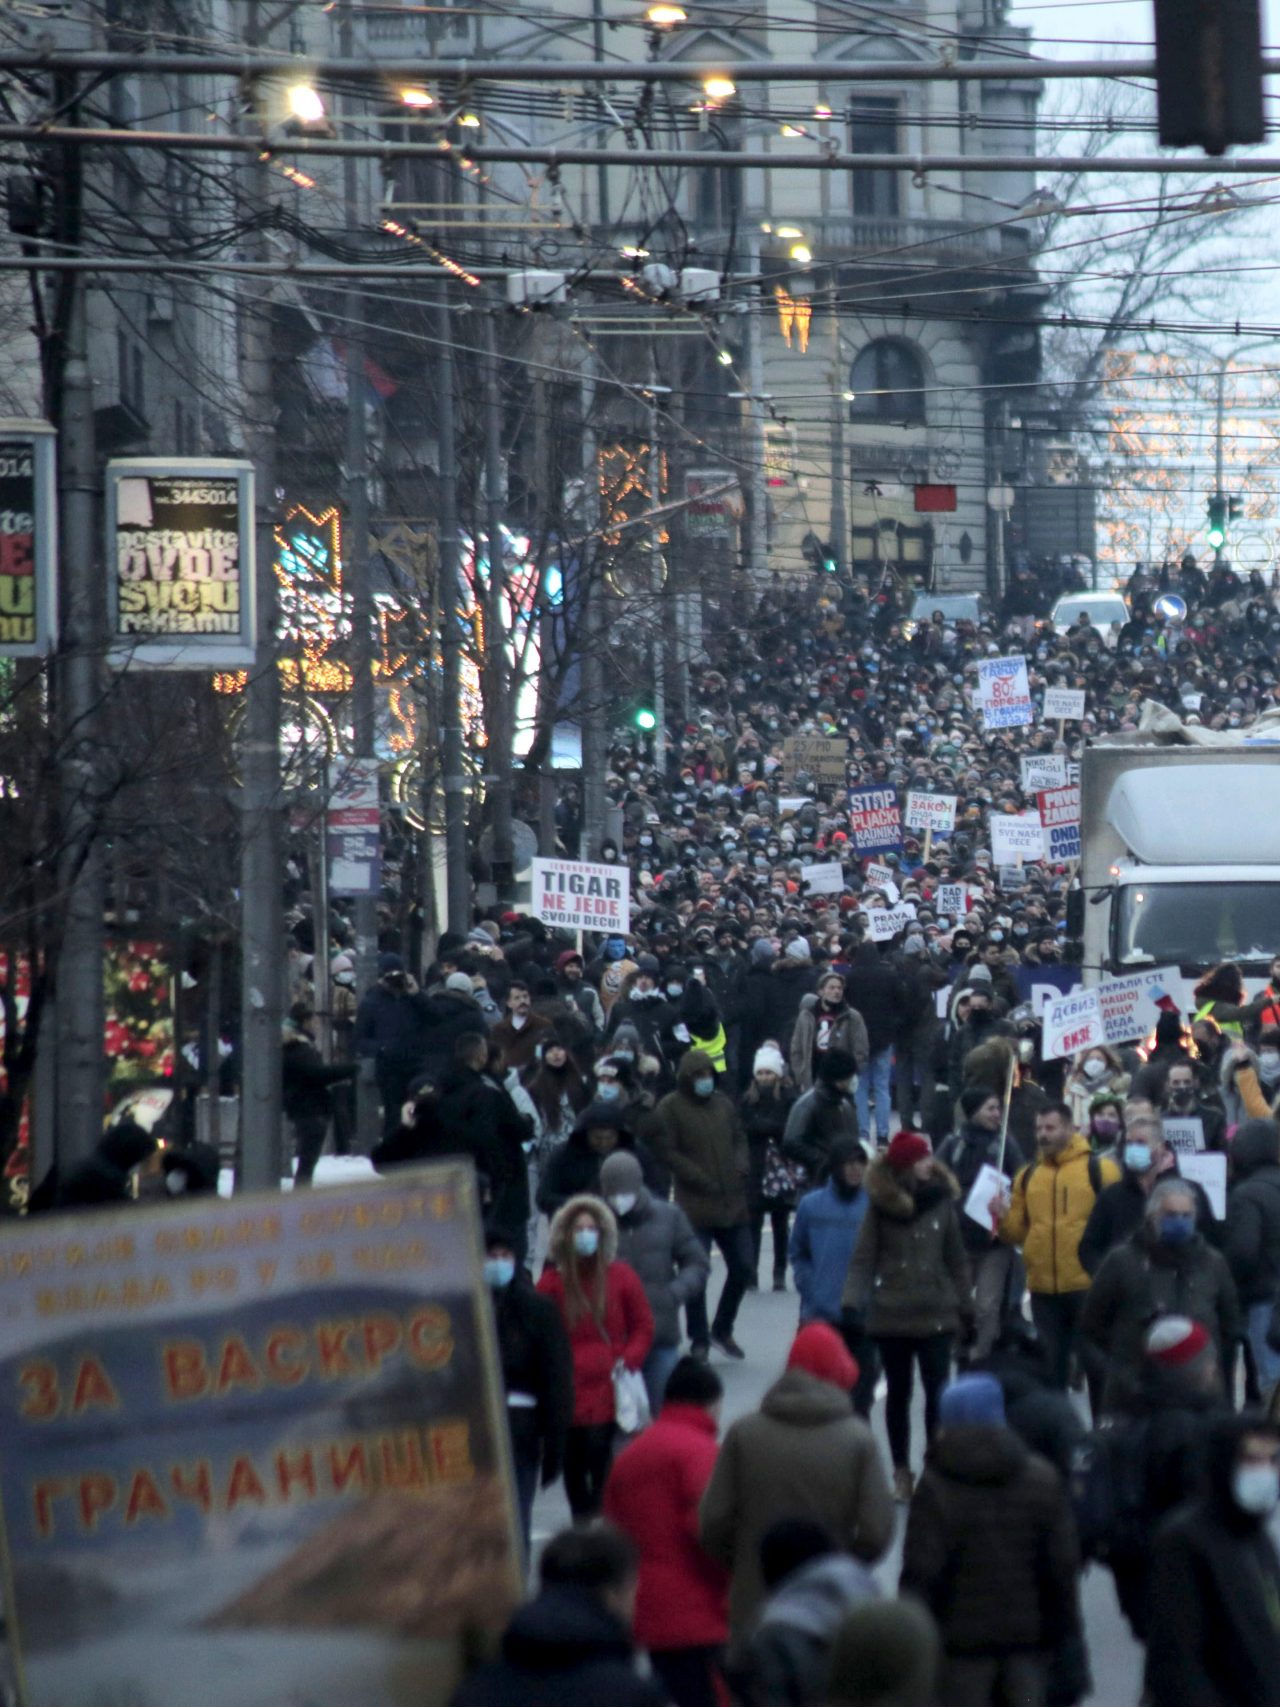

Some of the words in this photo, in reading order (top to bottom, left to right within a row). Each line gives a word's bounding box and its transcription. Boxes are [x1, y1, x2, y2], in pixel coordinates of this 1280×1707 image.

[172, 489, 237, 504] 3445014
[117, 529, 239, 550] postavite
[118, 549, 240, 581] OVDE
[120, 610, 240, 633] reklamu
[851, 789, 896, 813] STOP
[911, 800, 952, 813] ЗАКОН
[998, 829, 1015, 837] SVE
[1008, 837, 1031, 846] DECE
[1050, 826, 1080, 844] OND
[541, 871, 621, 899] TIGAR
[942, 887, 961, 896] RAD
[543, 893, 566, 911] NE
[574, 896, 619, 917] JEDE
[541, 910, 580, 924] SVOJU
[1099, 978, 1143, 994] УКРАЛИ
[1145, 973, 1165, 985] СТЕ
[1101, 990, 1139, 1005] НАШОЈ
[1052, 997, 1099, 1021] ДЕВИЗ
[1103, 1003, 1135, 1020] ДЕЦИ
[1105, 1016, 1135, 1030] ДЕДА
[1106, 1024, 1149, 1041] МРАЗА!
[1062, 1024, 1093, 1053] ВИЗЕ
[163, 1303, 455, 1399] ВАСКРС
[18, 1355, 122, 1420] ЗА
[33, 1418, 474, 1537] ГРАЧАНИЦЕ
